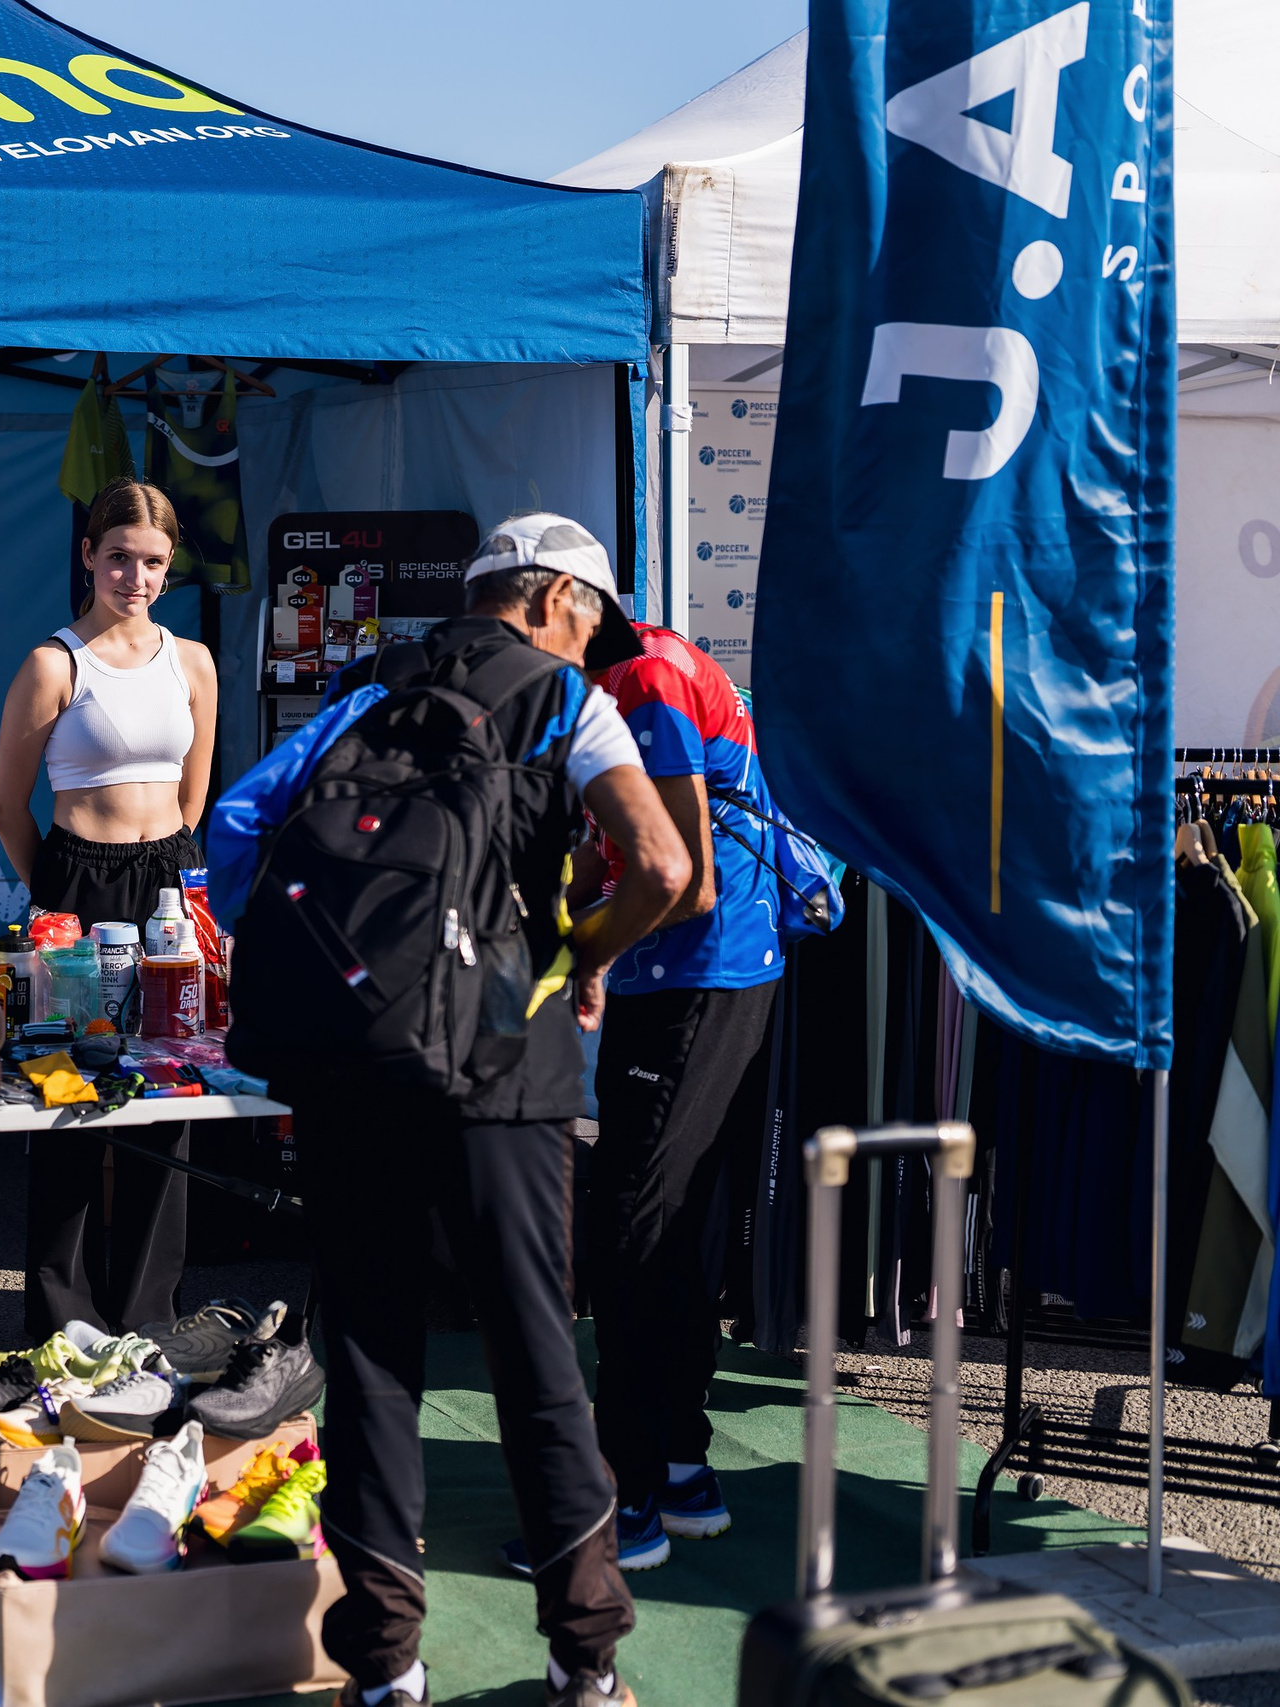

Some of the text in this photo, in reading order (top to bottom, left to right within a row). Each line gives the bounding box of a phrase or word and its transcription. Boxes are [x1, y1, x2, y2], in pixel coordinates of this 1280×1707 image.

[666, 207, 679, 273] AlphaTent.ru
[750, 403, 780, 411] РОССЕТ
[399, 562, 459, 571] SCIENCE
[346, 575, 363, 583] GU
[400, 571, 464, 579] IN SPORT
[179, 983, 198, 1001] ISO
